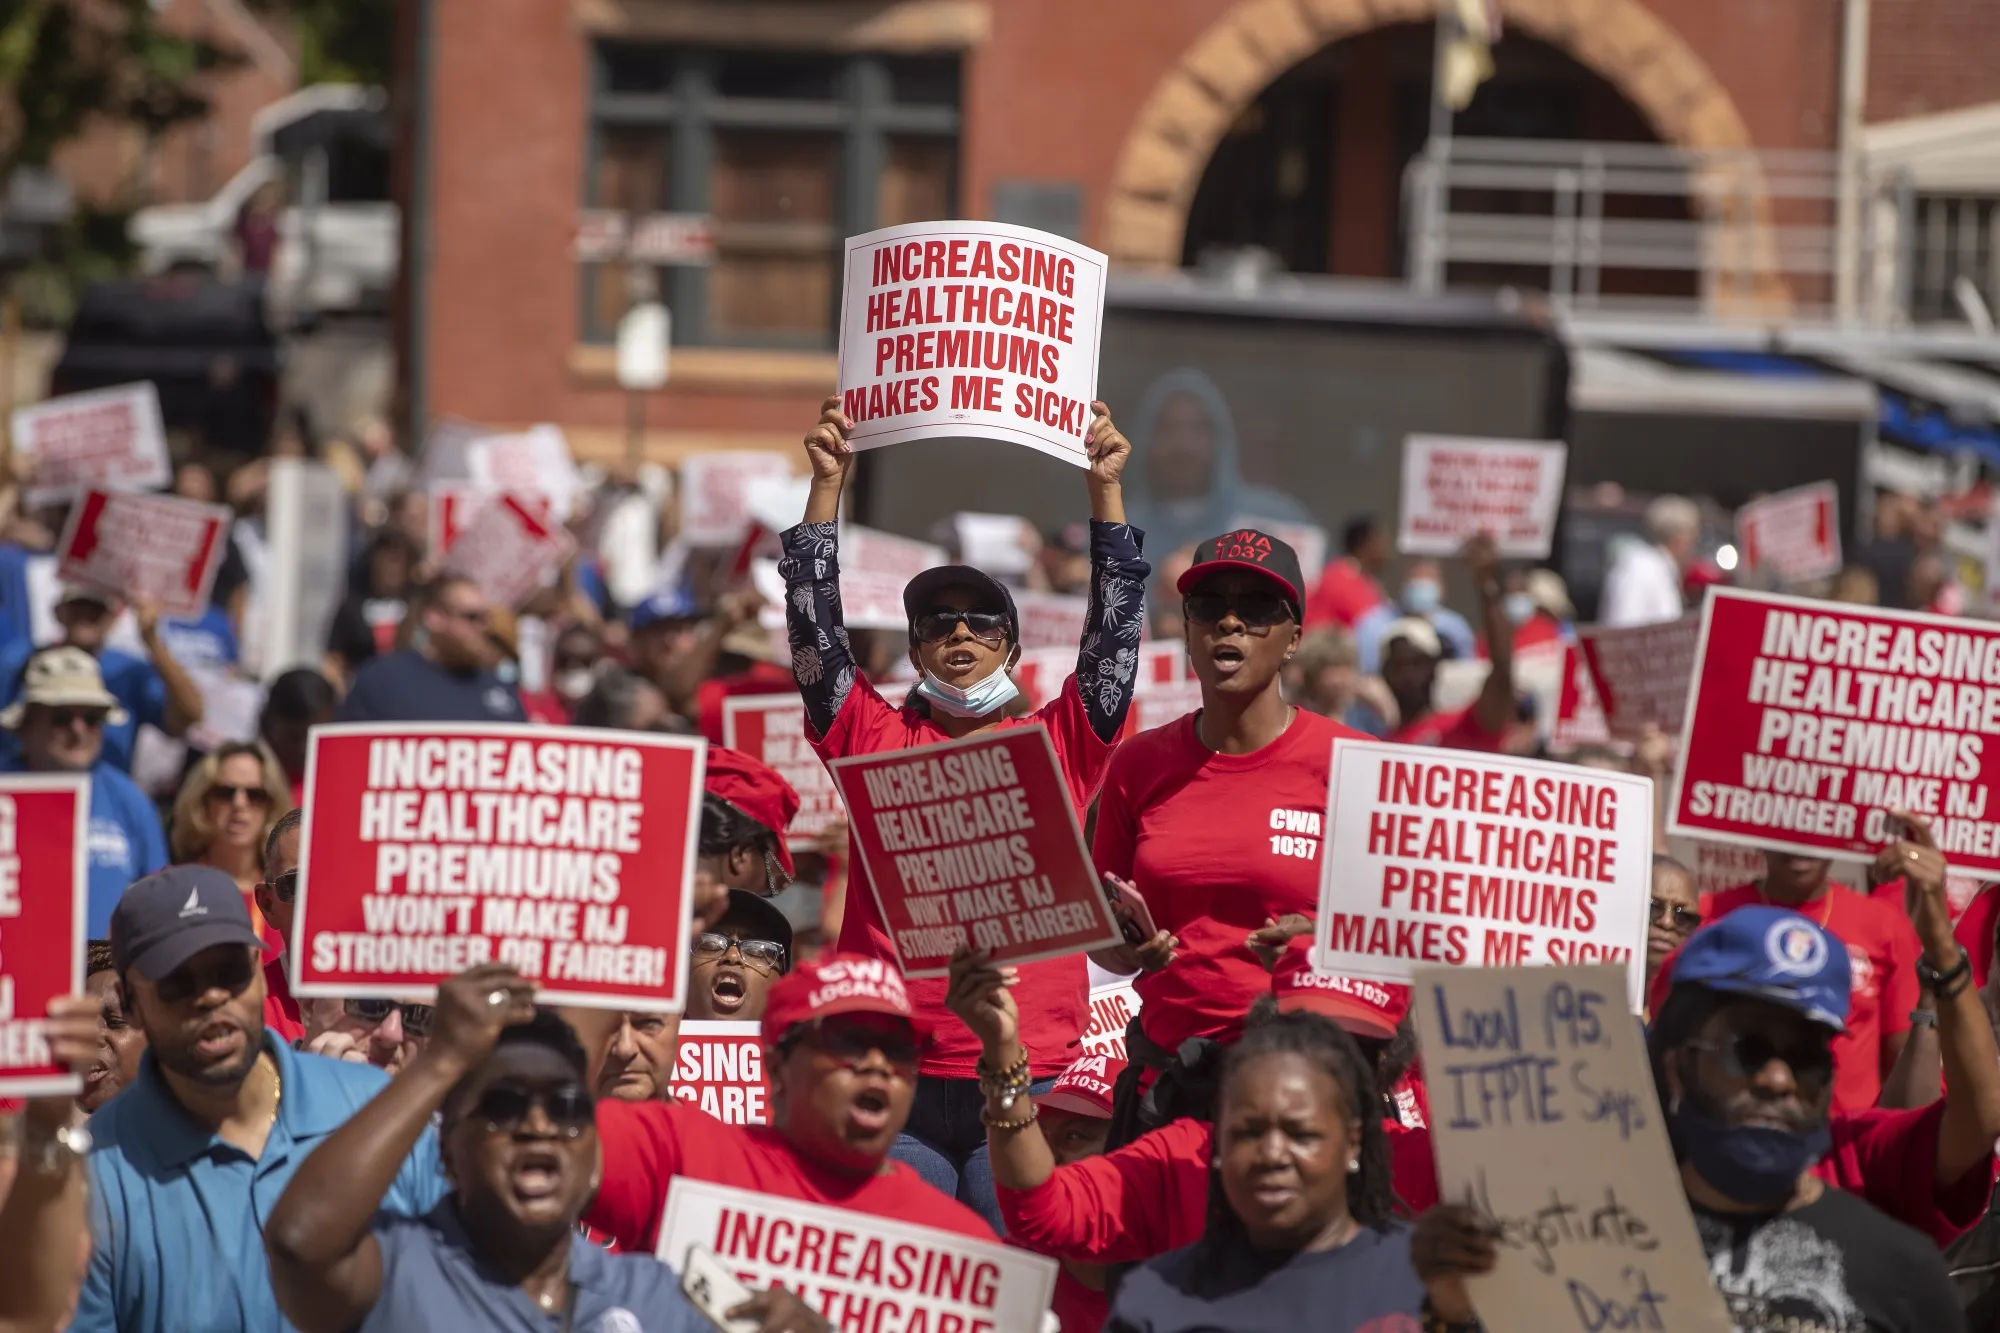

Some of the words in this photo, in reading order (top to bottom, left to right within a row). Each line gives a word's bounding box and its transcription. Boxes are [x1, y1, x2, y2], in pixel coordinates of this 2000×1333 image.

[872, 240, 1075, 299] INCREASING
[866, 284, 1075, 345] HEALTHCARE
[875, 330, 1059, 384] PREMIUMS
[844, 376, 939, 423] MAKES
[950, 375, 1002, 413] ME
[1014, 383, 1085, 437] SICK!
[1215, 544, 1270, 562] 1037
[1216, 531, 1272, 552] CWA
[1761, 609, 2000, 685] INCREASING
[1748, 656, 2000, 735] HEALTHCARE
[368, 738, 643, 800] INCREASING
[1757, 708, 1984, 781] PREMIUMS
[862, 746, 1020, 809] INCREASING
[1378, 759, 1618, 832] INCREASING
[1742, 752, 1848, 801] WON'T
[1852, 770, 1943, 814] MAKE
[1944, 780, 1989, 820] NJ
[360, 791, 644, 853] HEALTHCARE
[874, 788, 1036, 852] HEALTHCARE
[1270, 808, 1321, 836] CWA
[1689, 781, 1858, 838] STRONGER
[1863, 807, 1896, 844] O
[375, 843, 622, 904] PREMIUMS
[895, 835, 1036, 894] PREMIUMS
[1269, 835, 1318, 861] 1037
[1368, 811, 1619, 884] HEALTHCARE
[362, 895, 477, 935] WON'T
[483, 898, 579, 941] MAKE
[583, 905, 630, 945] NJ
[898, 925, 968, 959] STRONGER
[973, 920, 1009, 949] OR
[1008, 900, 1098, 944] FAIRER!
[904, 895, 952, 927] WON'T
[953, 882, 1021, 922] MAKE
[1020, 875, 1056, 909] NJ
[1381, 865, 1599, 933] PREMIUMS
[312, 932, 492, 974] STRONGER
[500, 938, 544, 977] OR
[548, 942, 667, 987] FAIRER!
[1330, 912, 1470, 966] MAKES
[1483, 928, 1534, 967] ME
[1071, 1075, 1111, 1095] 1037
[1445, 1055, 1565, 1130] IFPTE
[714, 1207, 1003, 1310] INCREASING
